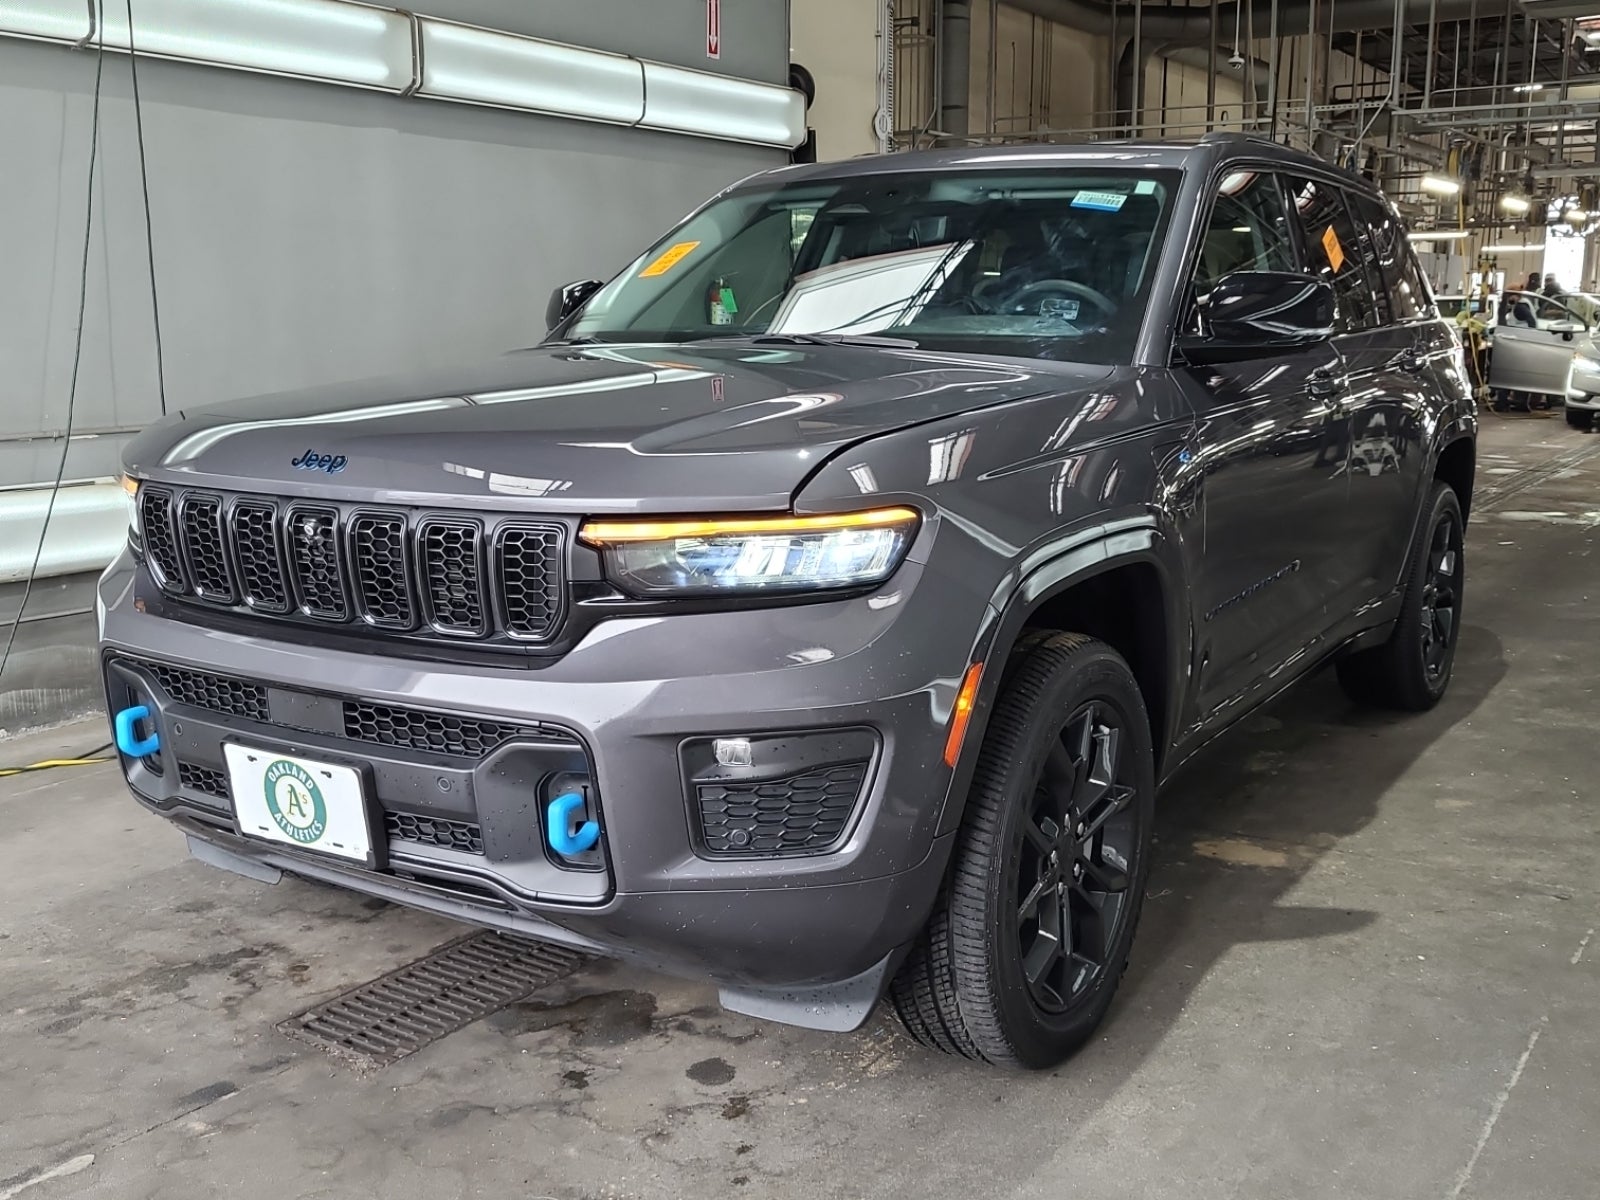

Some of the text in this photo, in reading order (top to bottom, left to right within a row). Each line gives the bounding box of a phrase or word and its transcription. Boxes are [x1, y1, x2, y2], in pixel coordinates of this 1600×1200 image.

[291, 449, 348, 474] Jeep
[268, 763, 314, 790] OAKLAND
[274, 813, 323, 841] ATHLETICS
